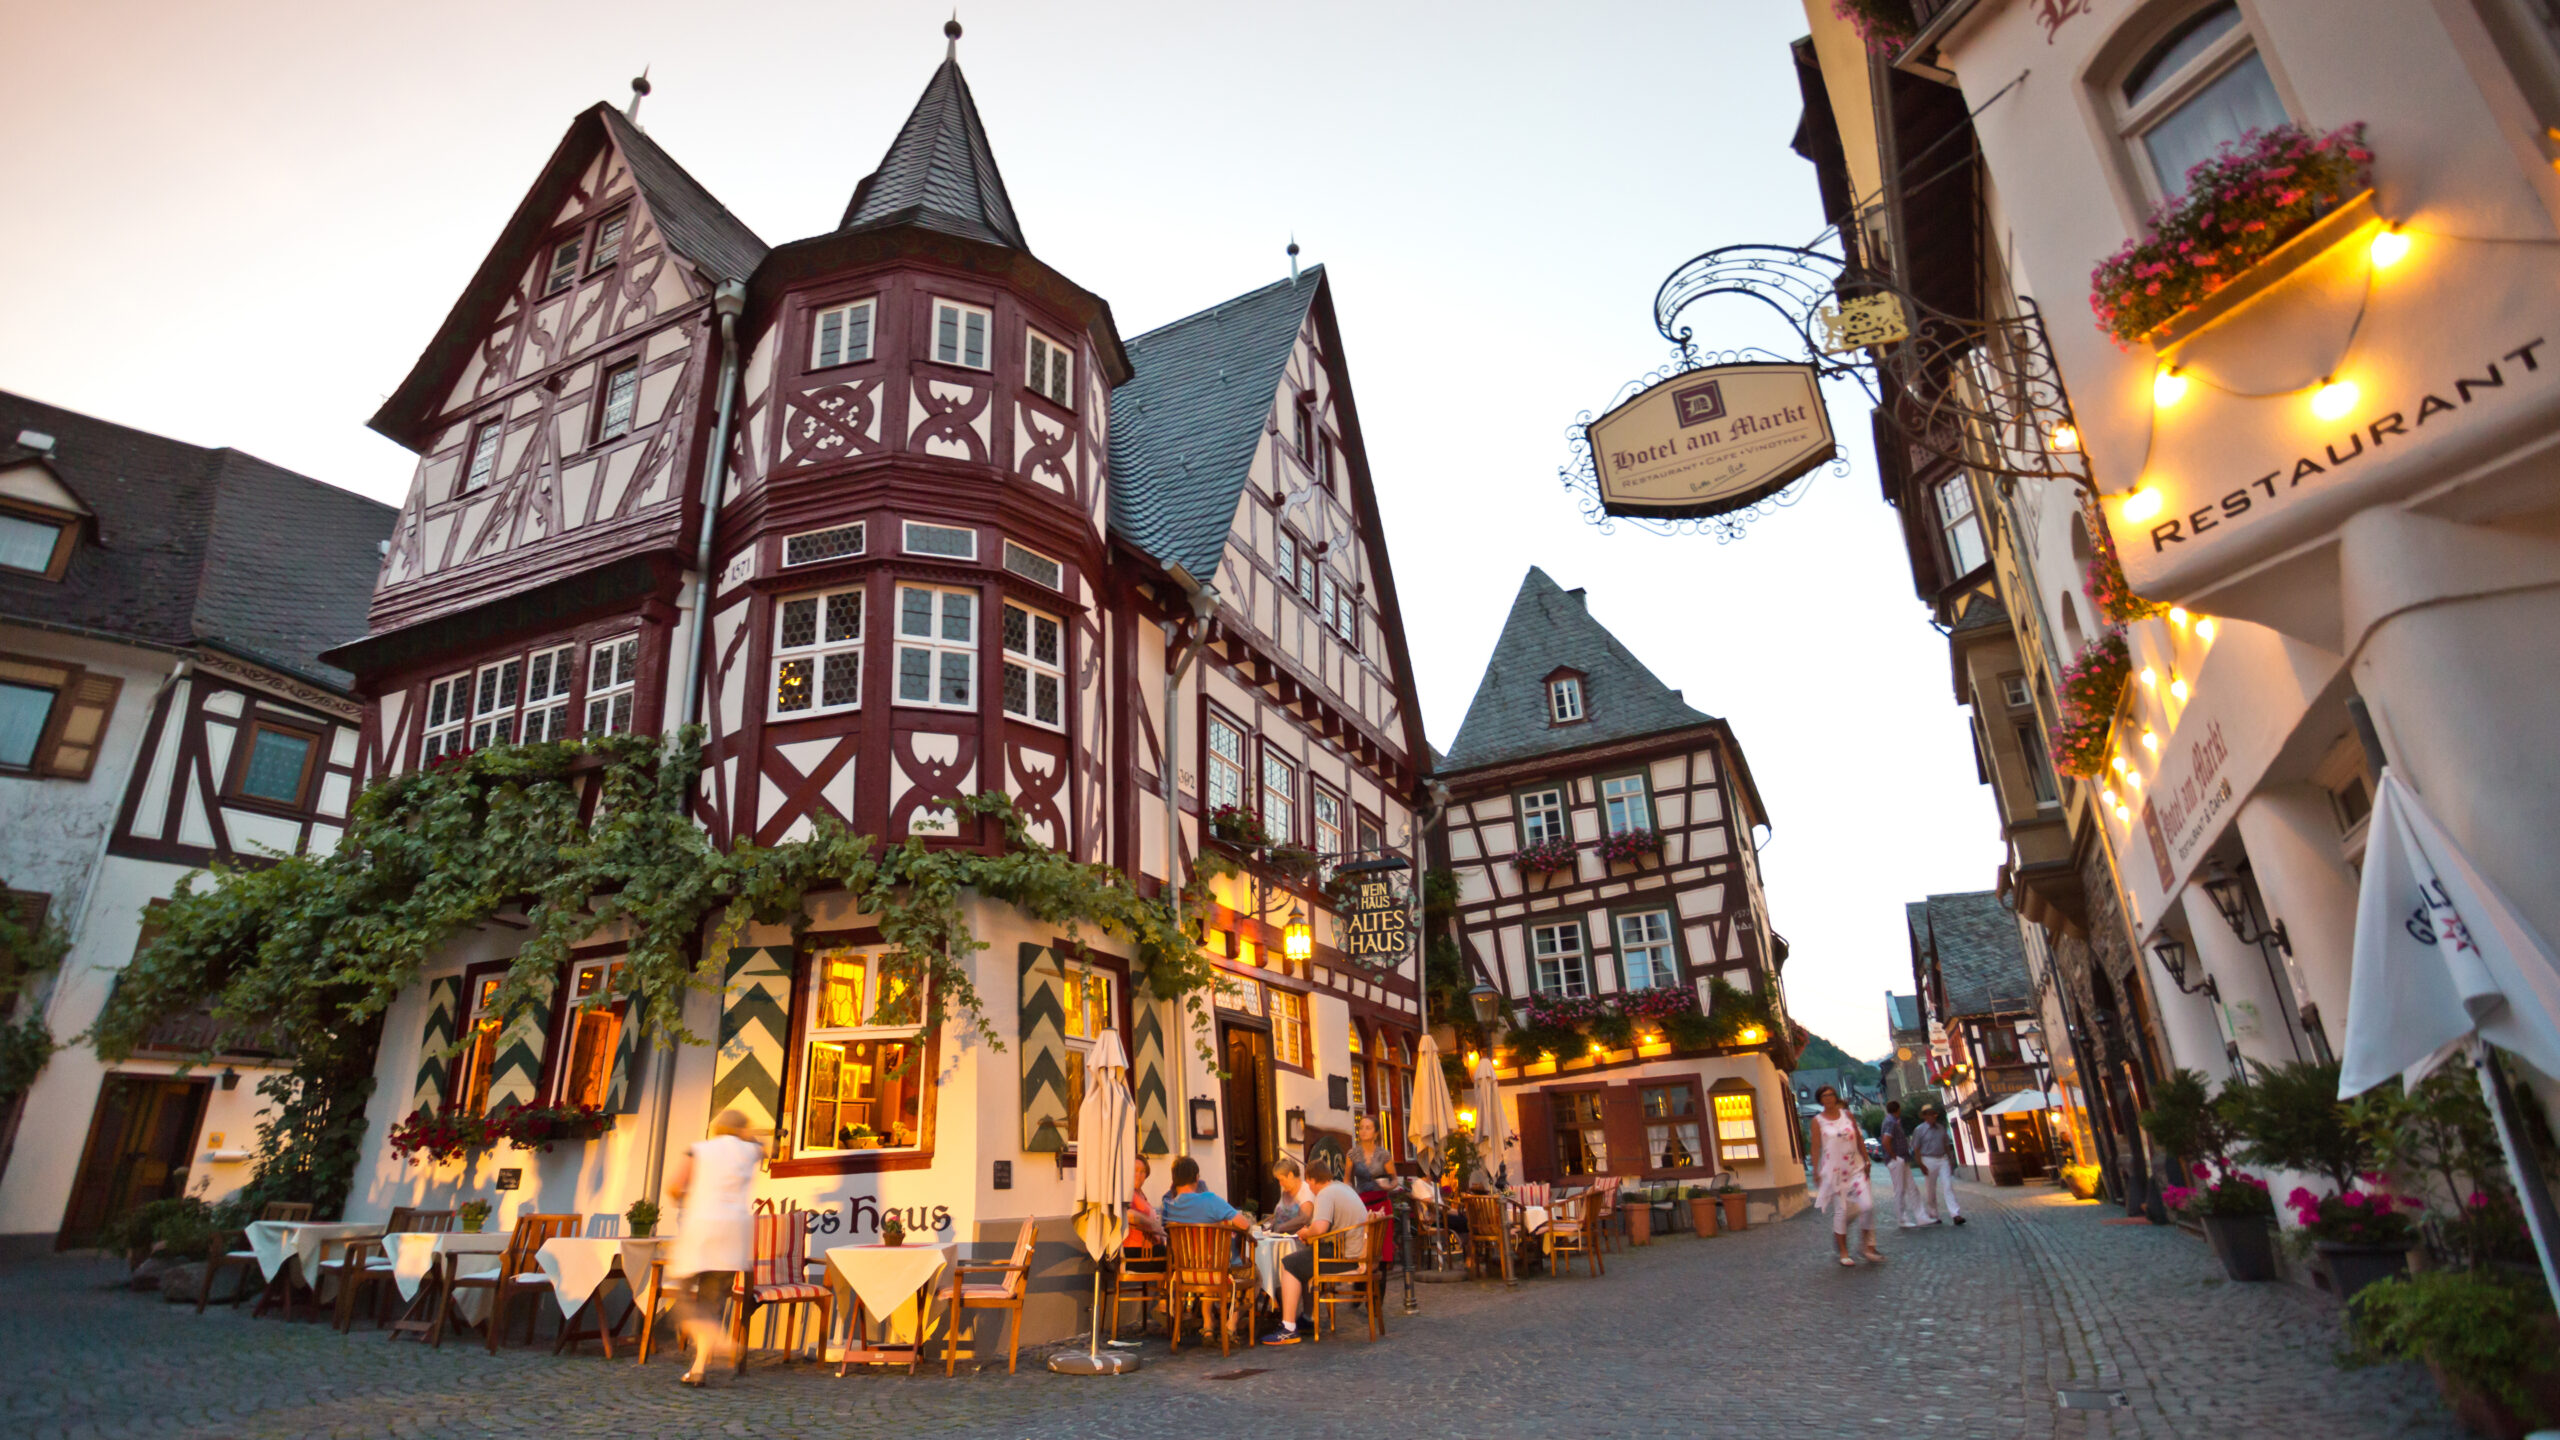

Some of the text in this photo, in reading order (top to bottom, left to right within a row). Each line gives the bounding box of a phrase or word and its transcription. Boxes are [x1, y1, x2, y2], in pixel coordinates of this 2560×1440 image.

[1611, 405, 1807, 475] Hotel am Markt
[2150, 337, 2546, 553] RESTAURANT
[1361, 882, 1388, 897] WEIN
[1361, 895, 1391, 910] HAUS
[1348, 909, 1405, 934] ALTES
[1350, 931, 1406, 955] HAUS
[848, 1195, 951, 1234] Haus
